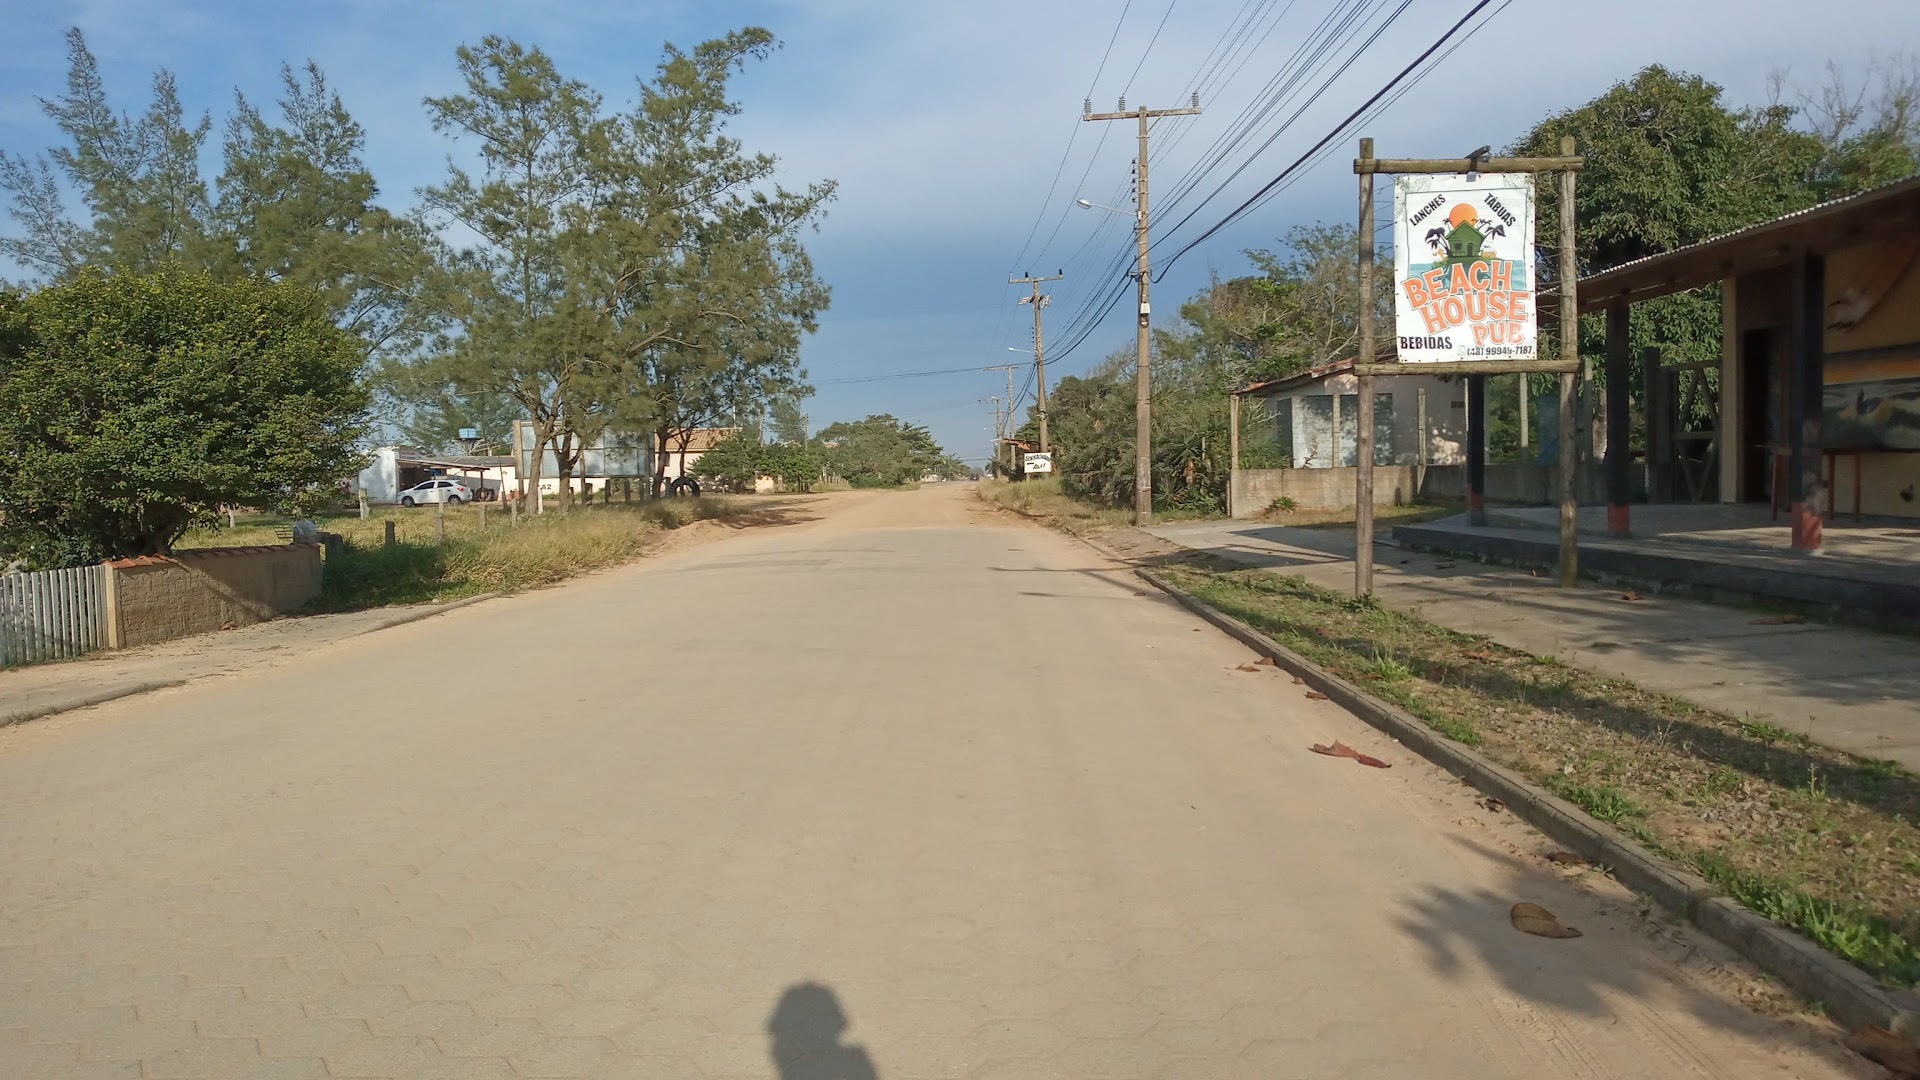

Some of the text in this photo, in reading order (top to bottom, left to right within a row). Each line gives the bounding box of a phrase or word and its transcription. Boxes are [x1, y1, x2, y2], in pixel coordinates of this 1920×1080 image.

[1409, 194, 1446, 227] LANCHES
[1484, 192, 1516, 227] TÁBUAS
[1401, 260, 1514, 310] BEACH
[1418, 290, 1531, 335] HOUSE
[1400, 336, 1453, 350] BEBIDAS
[1471, 321, 1525, 346] PUB
